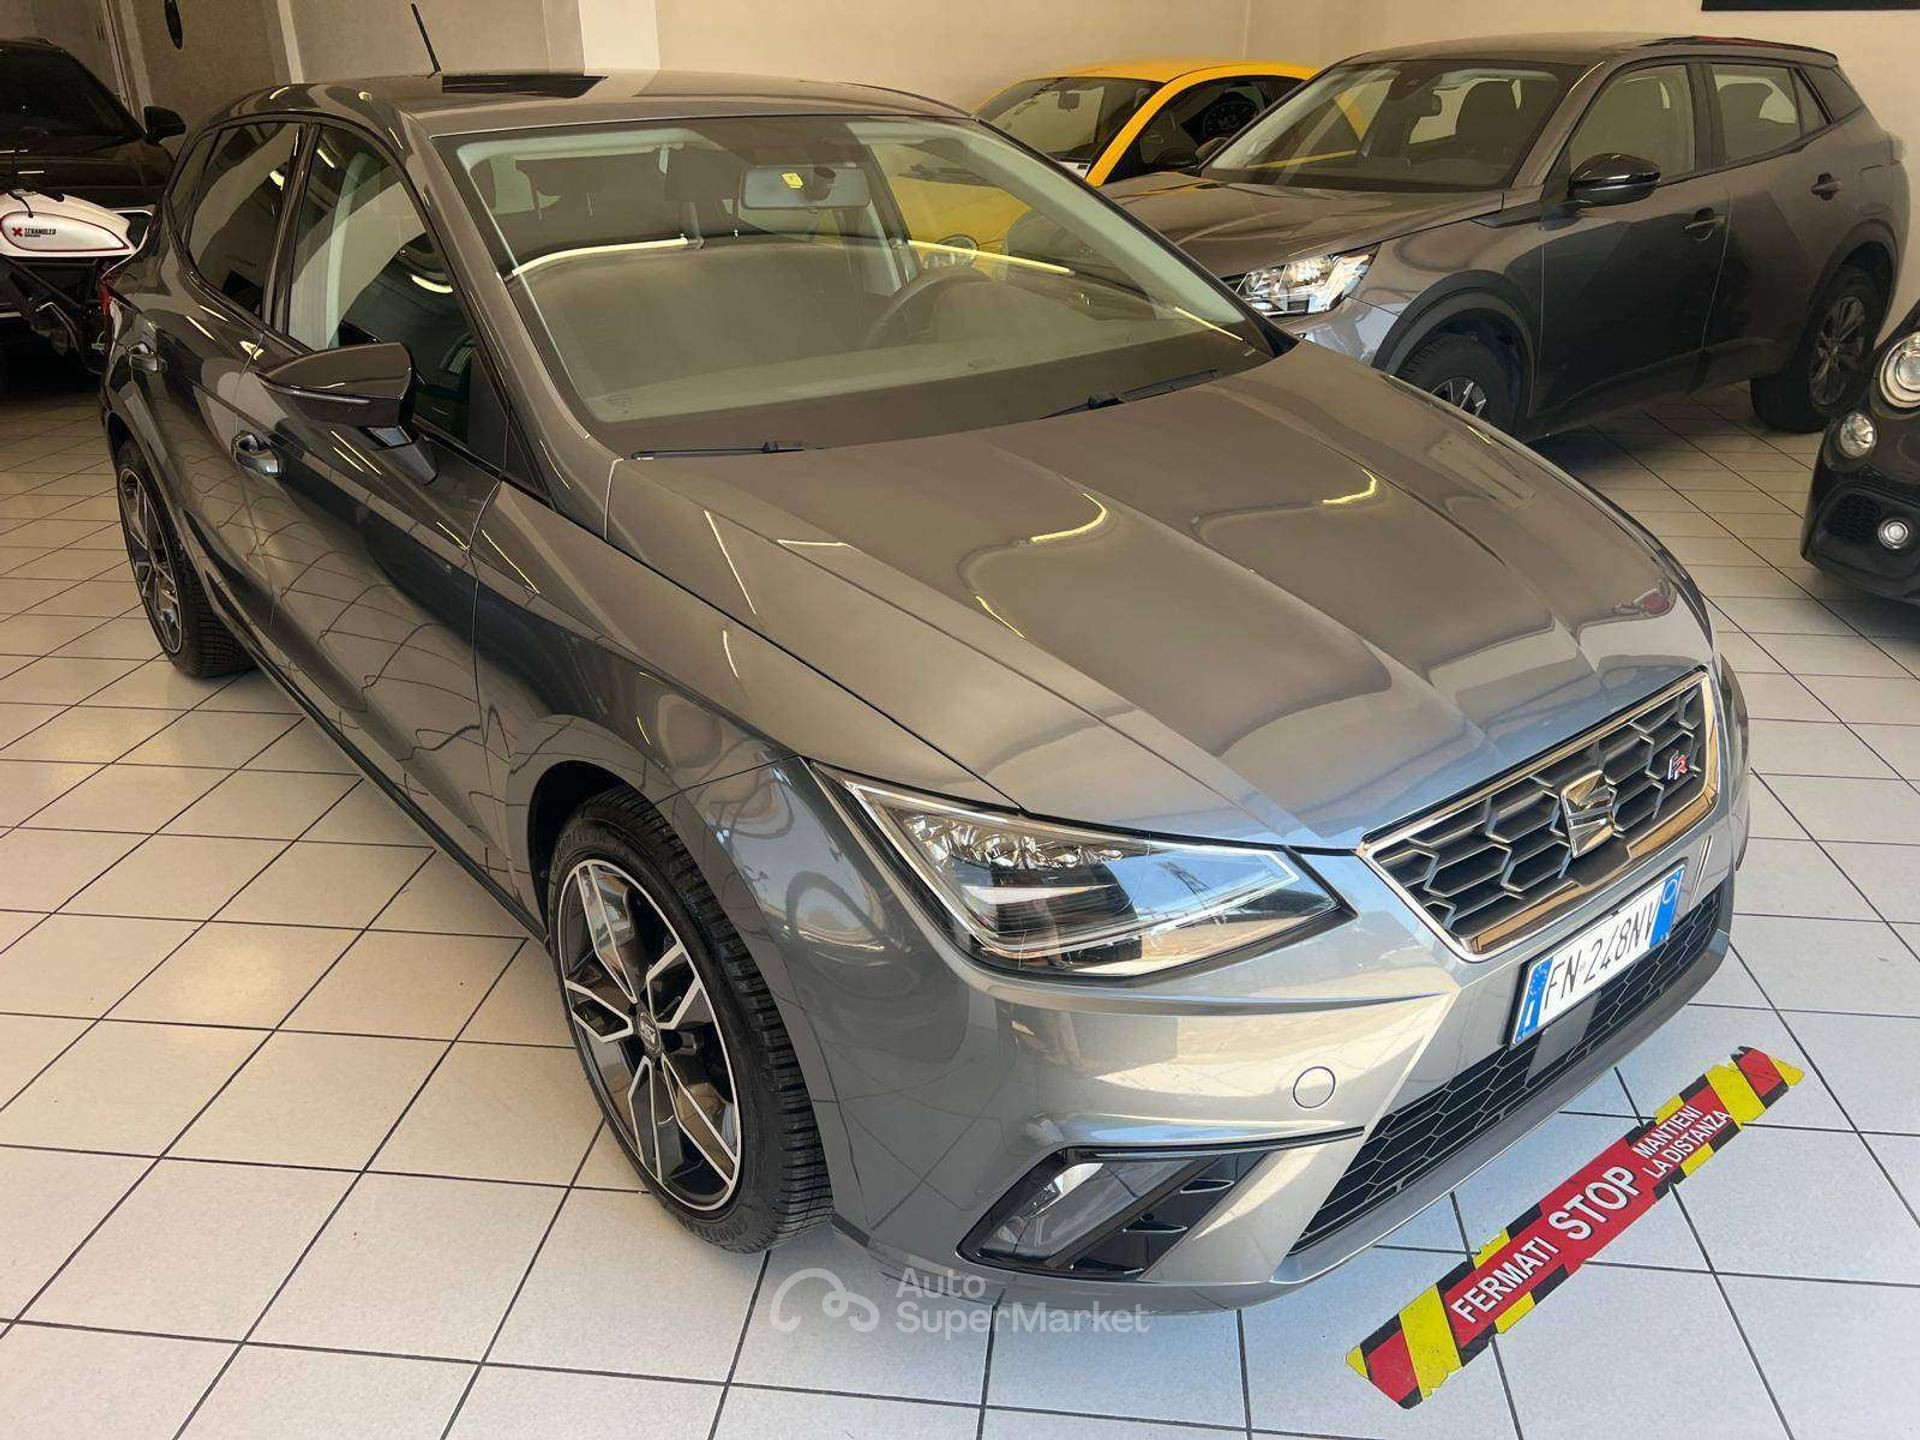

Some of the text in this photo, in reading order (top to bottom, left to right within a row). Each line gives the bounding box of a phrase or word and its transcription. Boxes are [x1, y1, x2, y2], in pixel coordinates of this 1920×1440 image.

[1631, 1104, 1705, 1160] MANTIENI
[1642, 1110, 1731, 1180] LA DISTANZA
[1548, 1165, 1642, 1242] STOP
[1450, 1235, 1560, 1325] FERMATI
